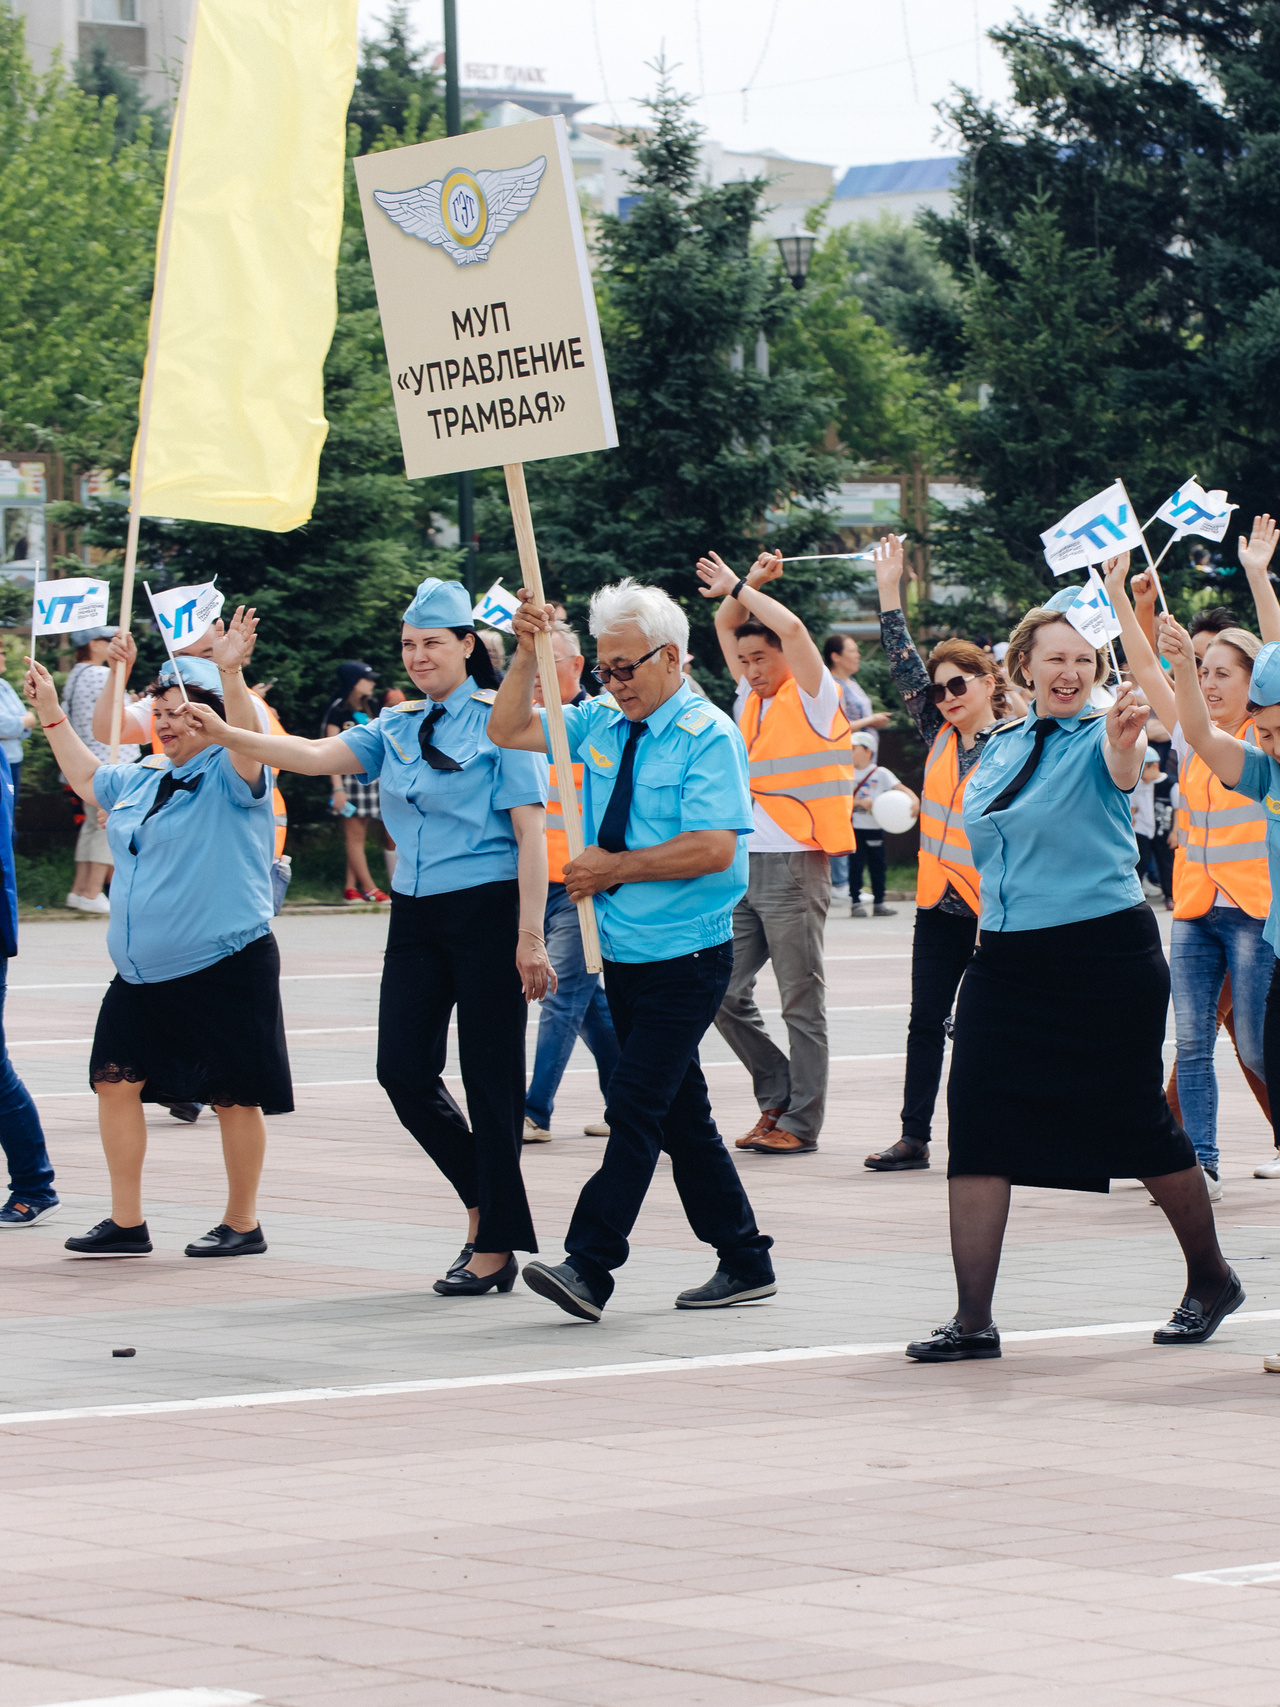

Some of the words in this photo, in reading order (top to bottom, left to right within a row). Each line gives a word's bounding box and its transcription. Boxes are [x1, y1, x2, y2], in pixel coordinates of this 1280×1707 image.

[452, 190, 475, 228] ГЭТ
[451, 301, 510, 341] МУП
[397, 336, 585, 396] «УПРАВЛЕНИЕ
[427, 391, 566, 439] ТРАМВАЯ»
